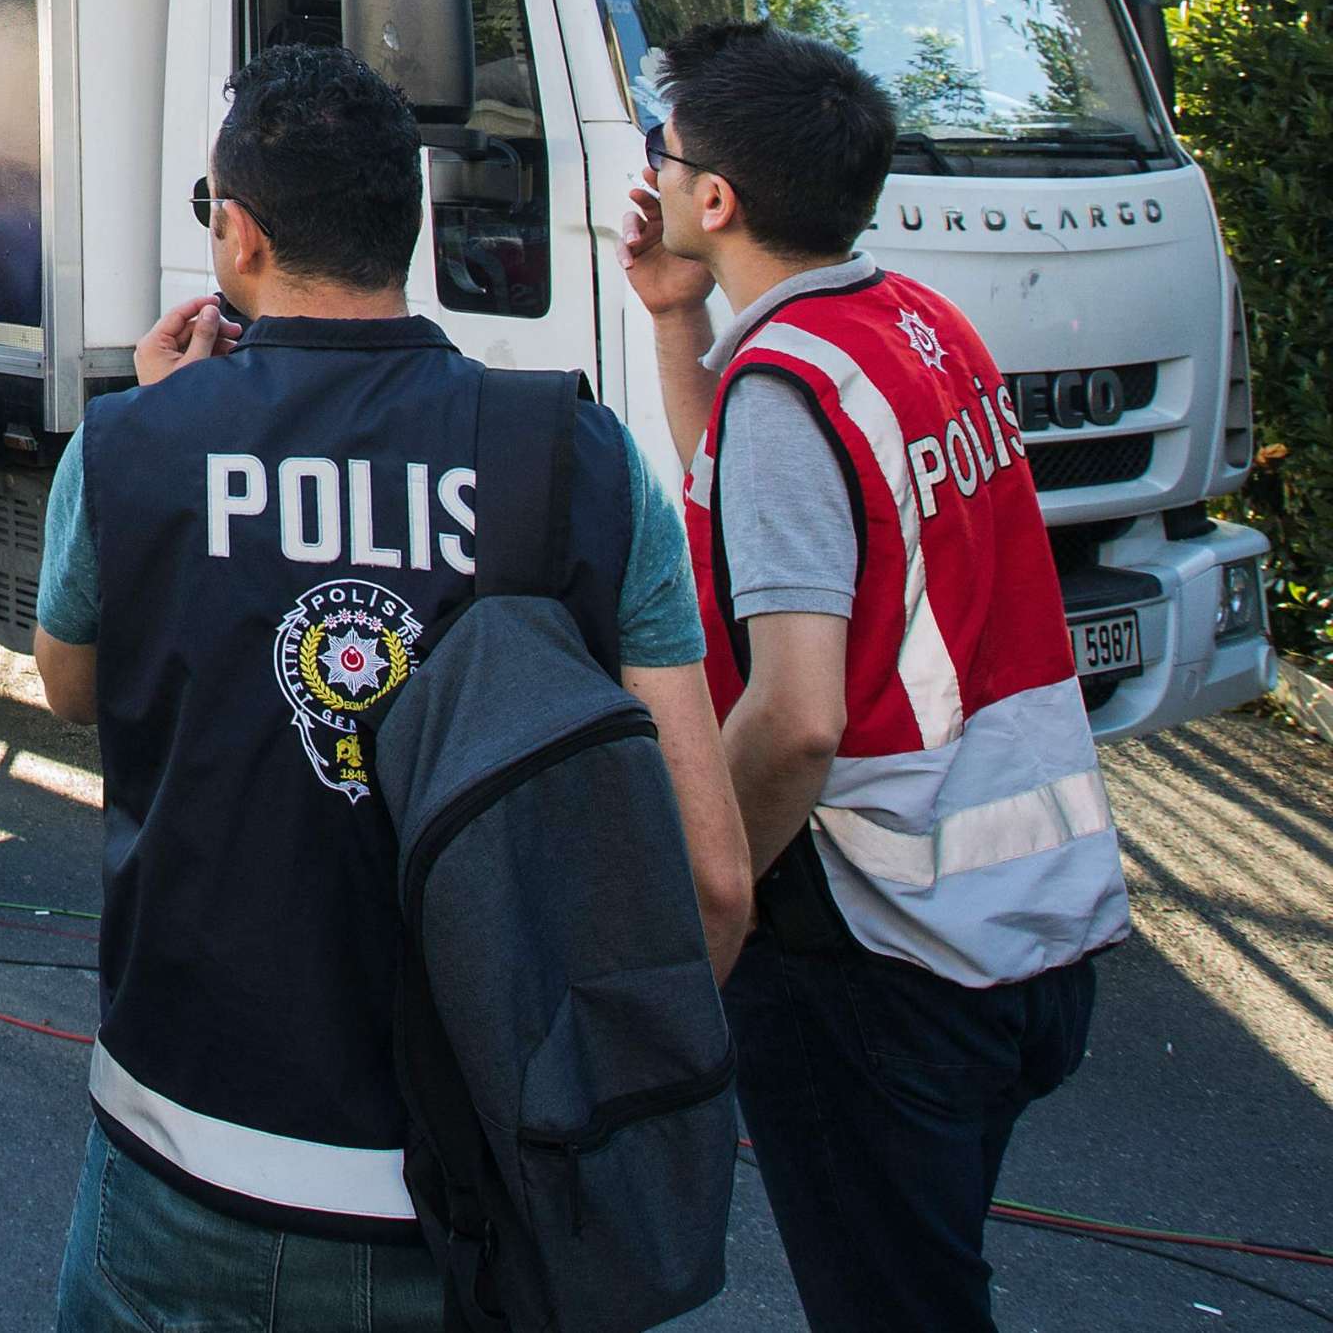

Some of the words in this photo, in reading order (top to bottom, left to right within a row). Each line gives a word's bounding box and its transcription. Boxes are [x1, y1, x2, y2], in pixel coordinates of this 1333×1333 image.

[866, 197, 1163, 232] UROCARGO
[1017, 368, 1124, 431] ECO
[907, 375, 1025, 520] POLİS
[1086, 620, 1133, 667] 5987
[322, 709, 357, 730] GEN
